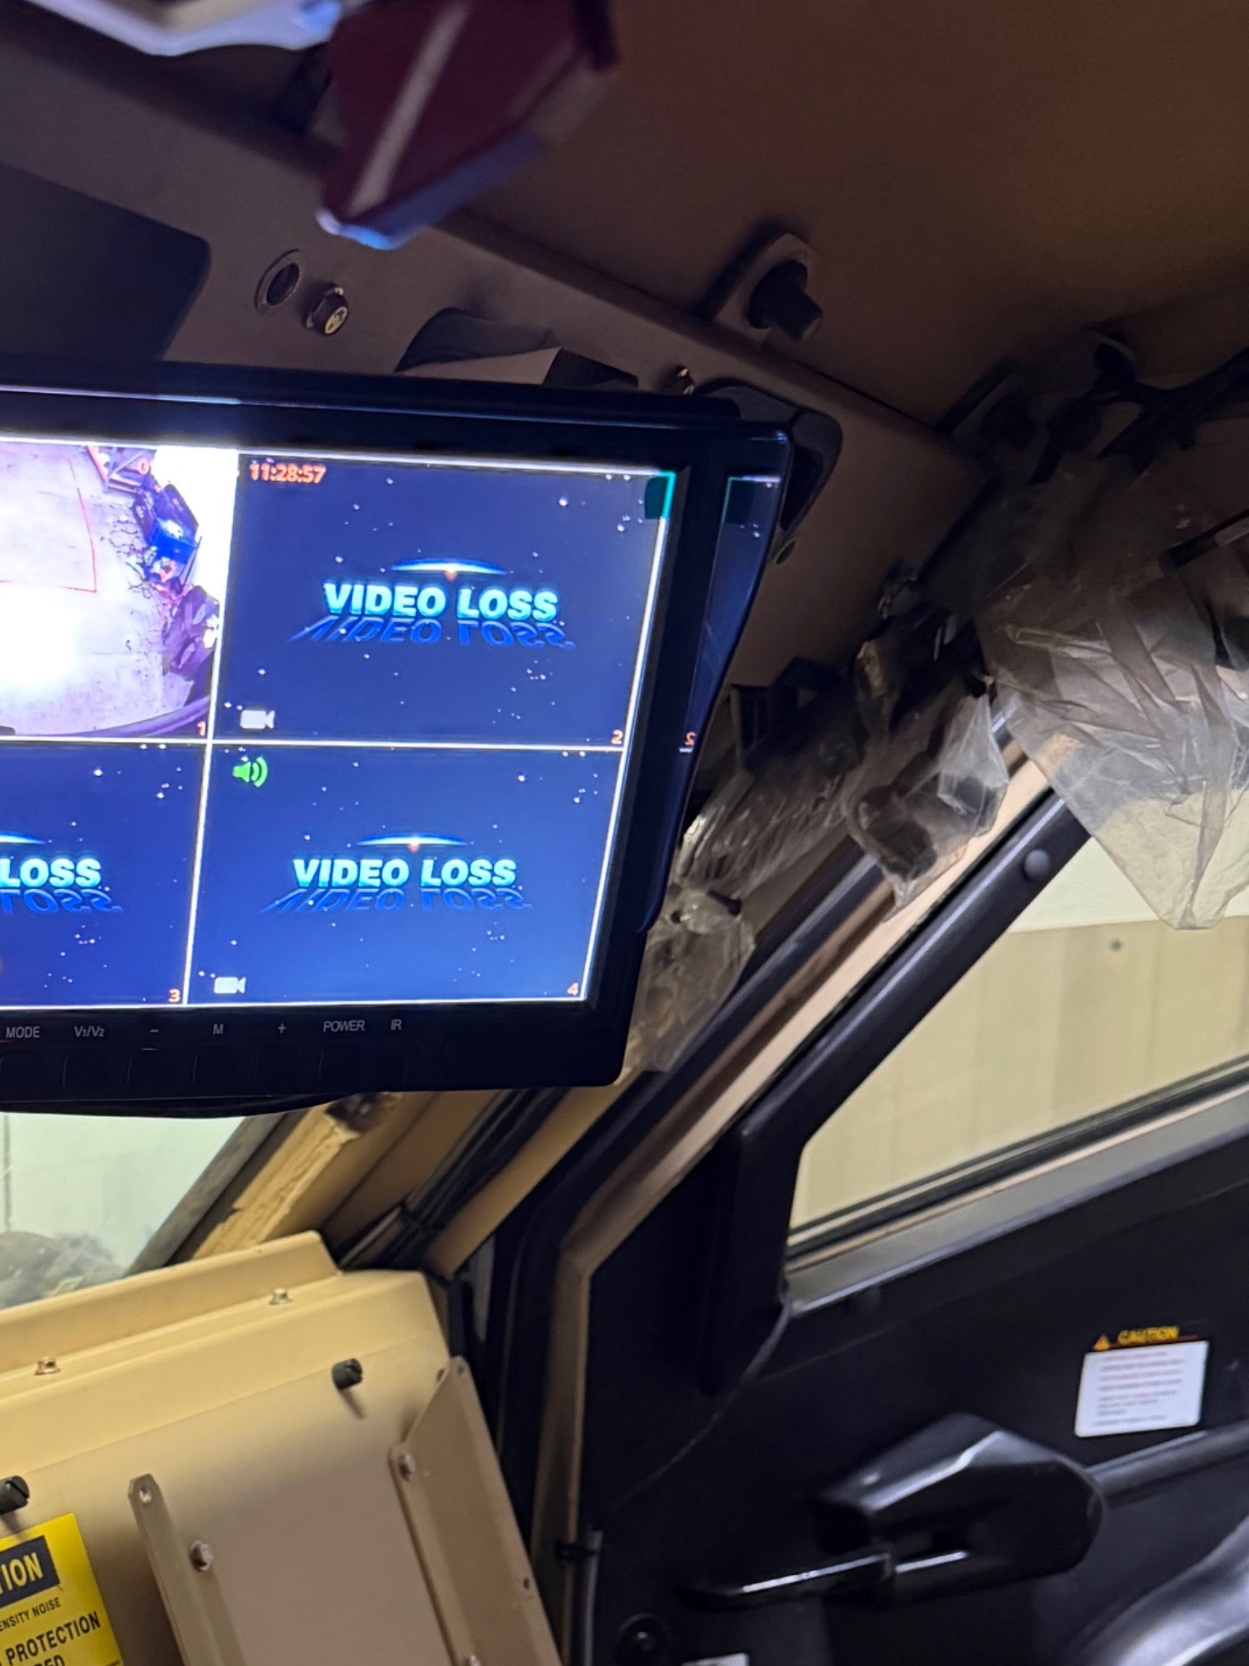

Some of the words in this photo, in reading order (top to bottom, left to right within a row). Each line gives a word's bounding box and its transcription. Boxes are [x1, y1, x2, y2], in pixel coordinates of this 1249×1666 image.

[250, 463, 325, 484] 11:28:57
[324, 582, 446, 617] VIDEO
[457, 587, 559, 621] LOSS
[611, 731, 623, 744] 2
[293, 859, 408, 887] VIDEO
[420, 859, 516, 886] LOSS
[169, 989, 179, 1003] 3
[567, 983, 578, 995] 4
[214, 1024, 223, 1034] M
[323, 1020, 365, 1032] POWER
[391, 1019, 402, 1030] IR
[6, 1026, 40, 1039] MODE
[1118, 1327, 1179, 1344] CAUTION
[32, 1597, 61, 1618] NOISE
[5, 1611, 101, 1666] PROTECTION
